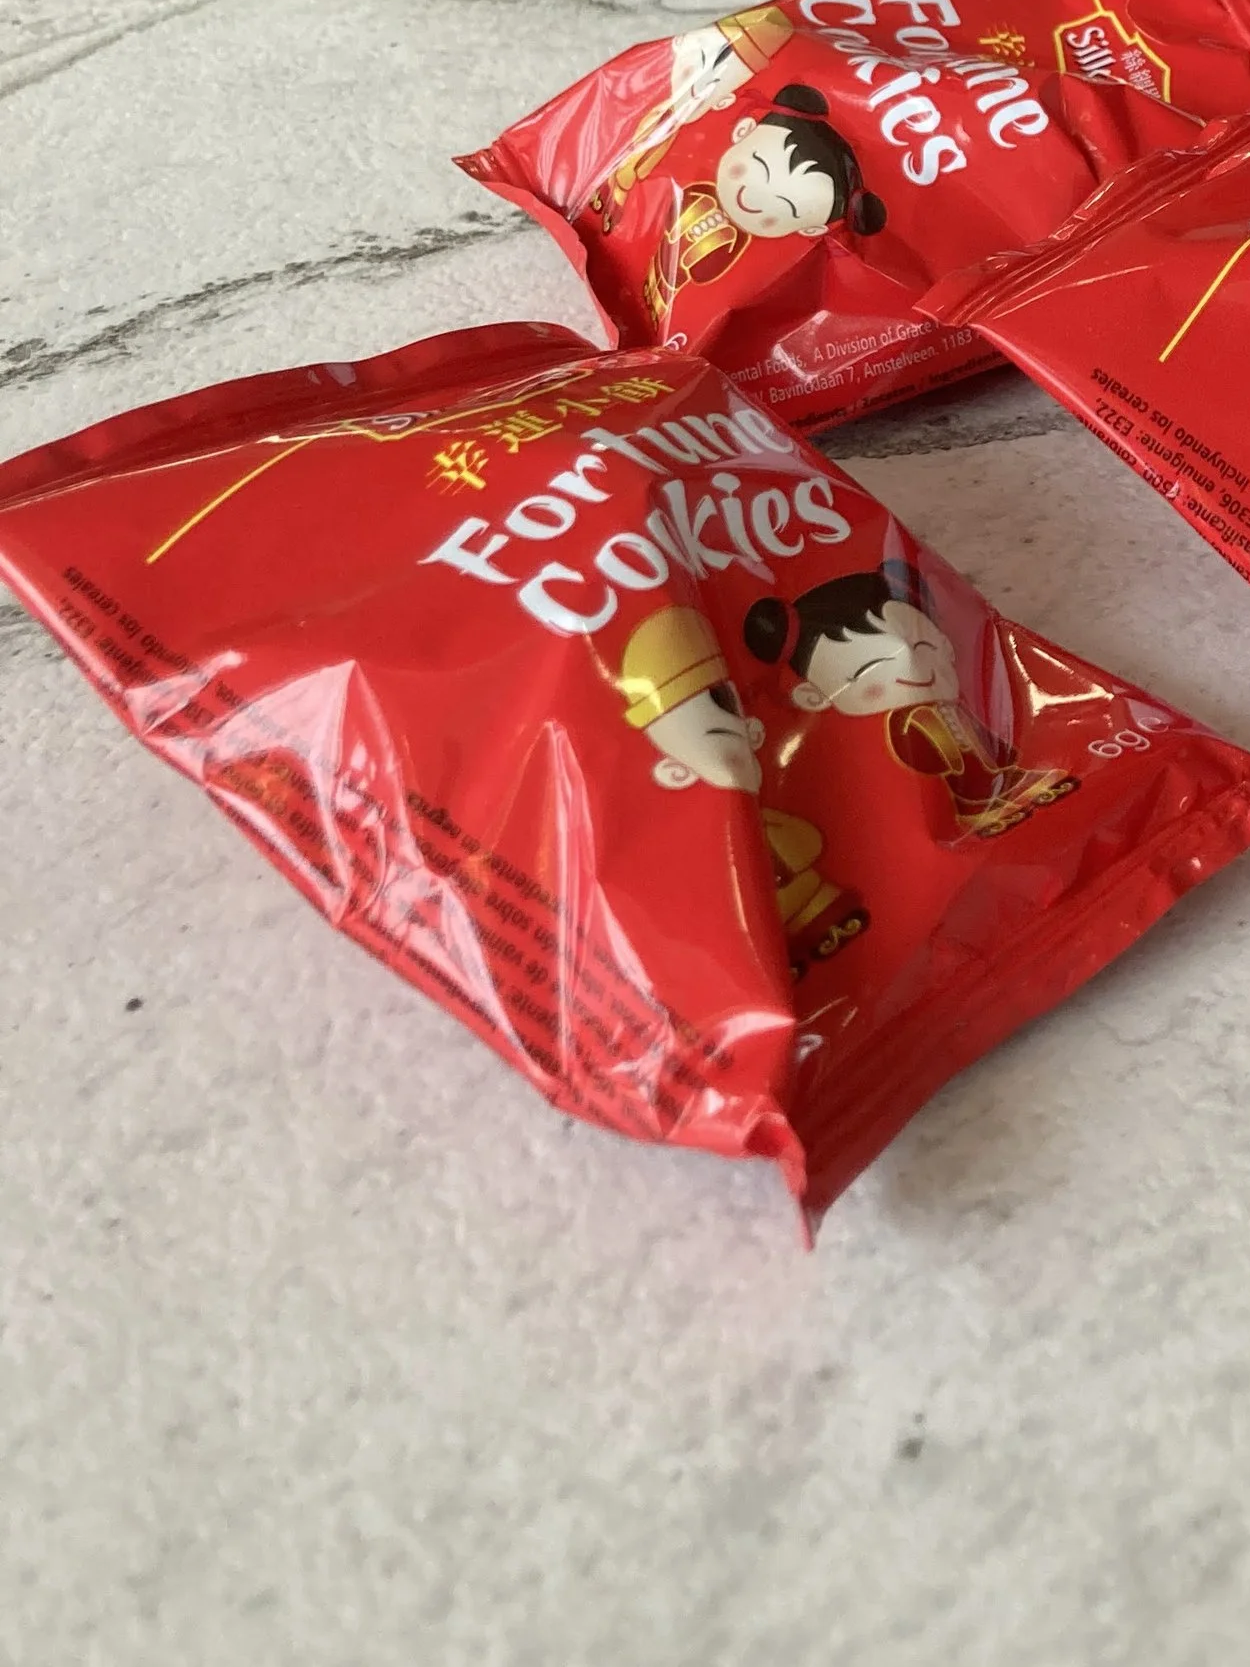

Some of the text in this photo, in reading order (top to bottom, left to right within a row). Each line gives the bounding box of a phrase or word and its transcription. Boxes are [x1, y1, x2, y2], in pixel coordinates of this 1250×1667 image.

[1061, 25, 1118, 82] Silk
[811, 345, 824, 362] A
[825, 329, 877, 359] Division
[878, 326, 895, 344] of
[895, 317, 932, 341] Grace
[941, 327, 973, 352] 1183
[1087, 365, 1151, 418] cereales
[1089, 396, 1135, 437] E322,
[1145, 408, 1174, 435] los
[1133, 426, 1218, 497] emulgente:
[416, 408, 794, 584] Fortune
[516, 472, 852, 635] Cookies
[479, 890, 534, 935] sobre
